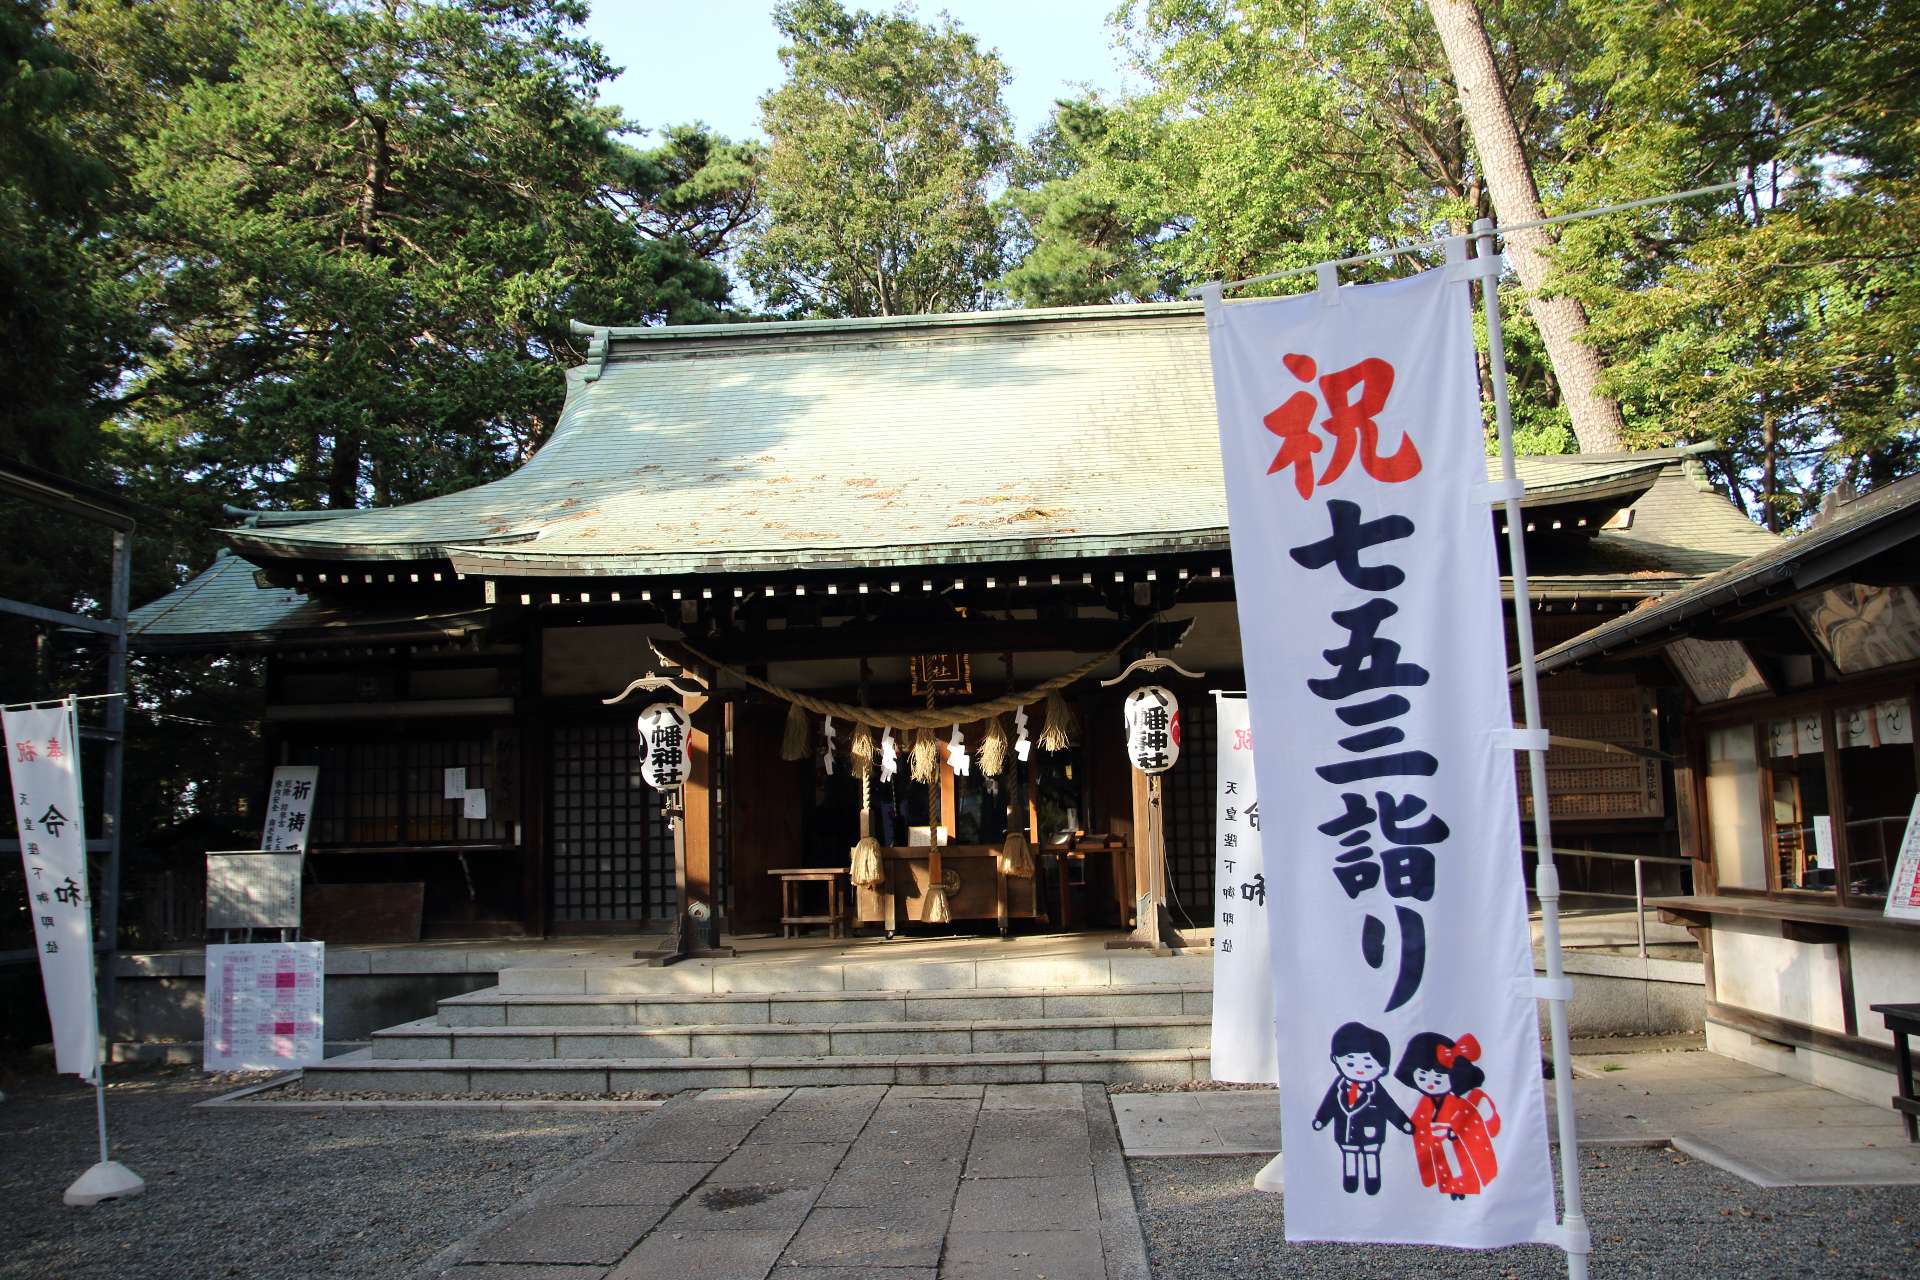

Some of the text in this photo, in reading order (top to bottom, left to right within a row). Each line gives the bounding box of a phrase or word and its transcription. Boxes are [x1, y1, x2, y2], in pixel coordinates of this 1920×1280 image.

[651, 707, 683, 785] 八幡神社
[1131, 689, 1168, 768] 八幡神社
